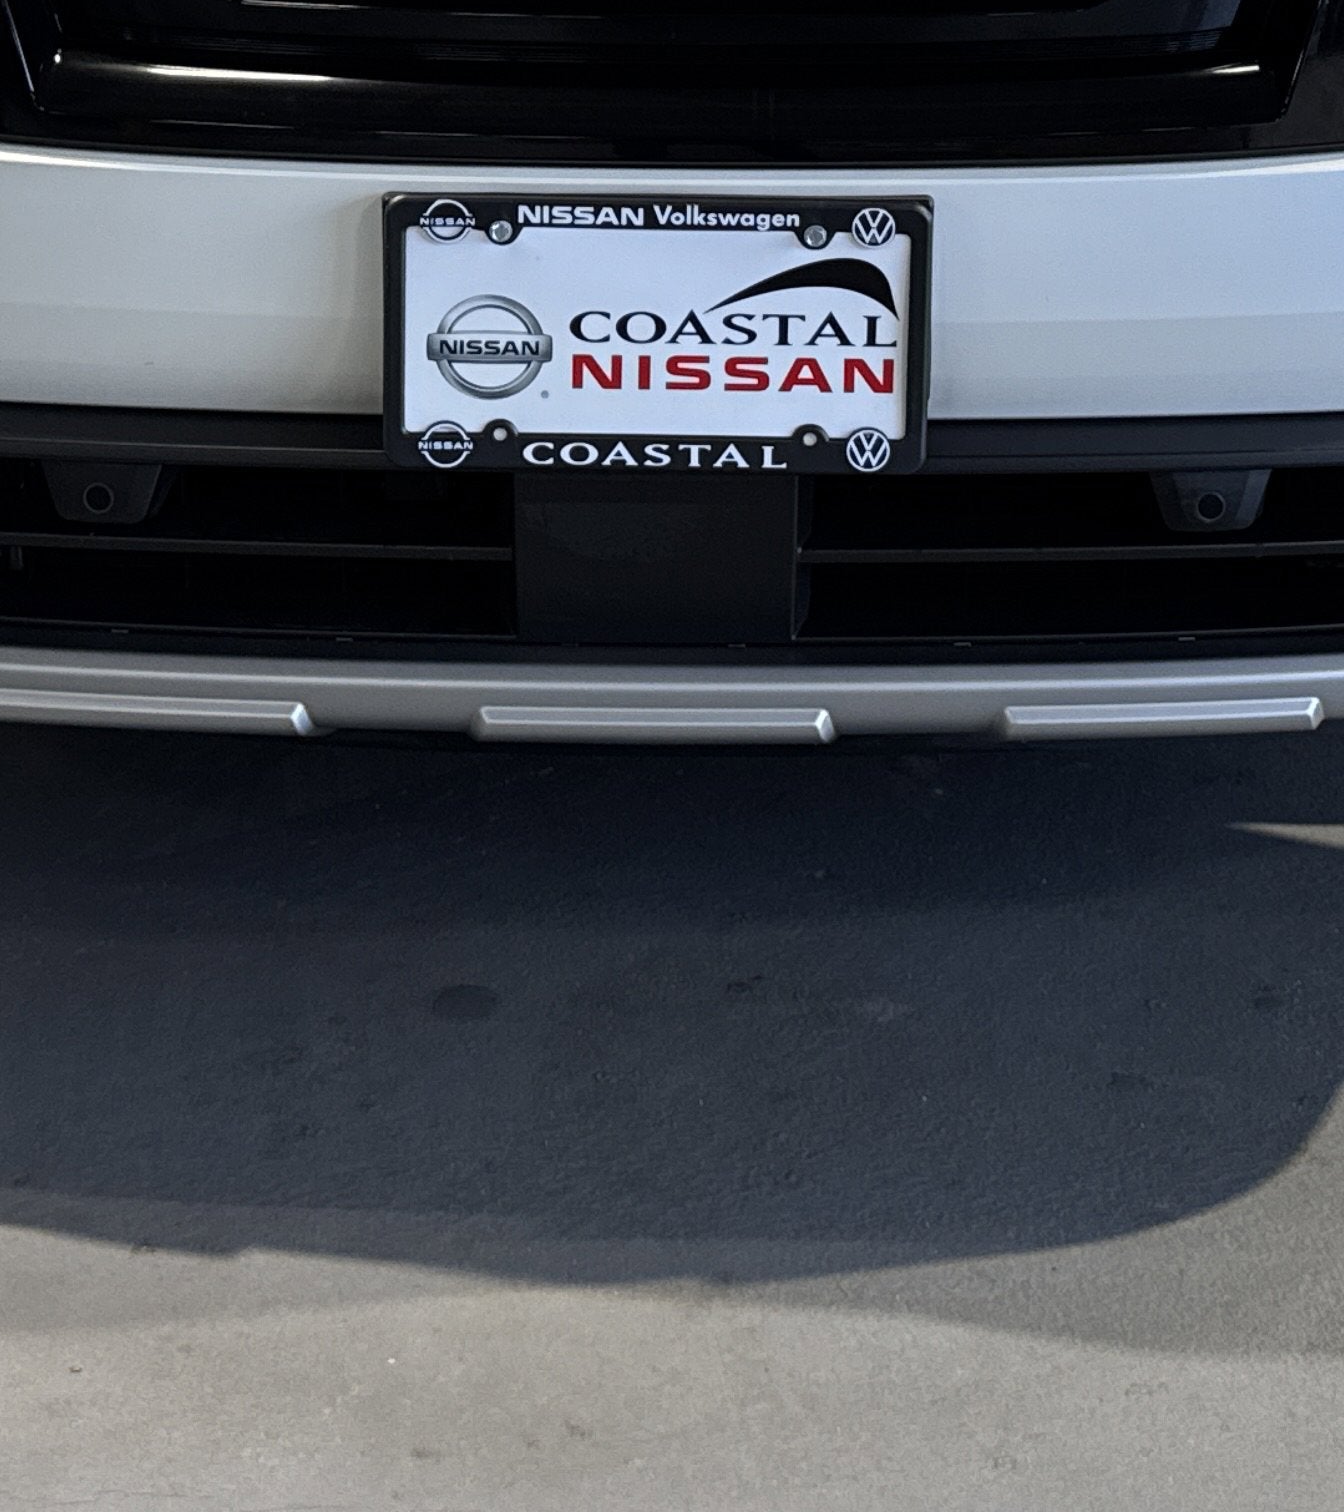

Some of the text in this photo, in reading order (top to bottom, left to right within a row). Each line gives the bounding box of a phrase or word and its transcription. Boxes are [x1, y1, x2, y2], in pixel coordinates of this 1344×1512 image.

[517, 205, 800, 230] NISSAN Volkswagen
[569, 311, 897, 348] COASTAL
[438, 338, 540, 357] NISSAN
[571, 354, 894, 394] NISSAN
[523, 442, 787, 469] COASTAL
